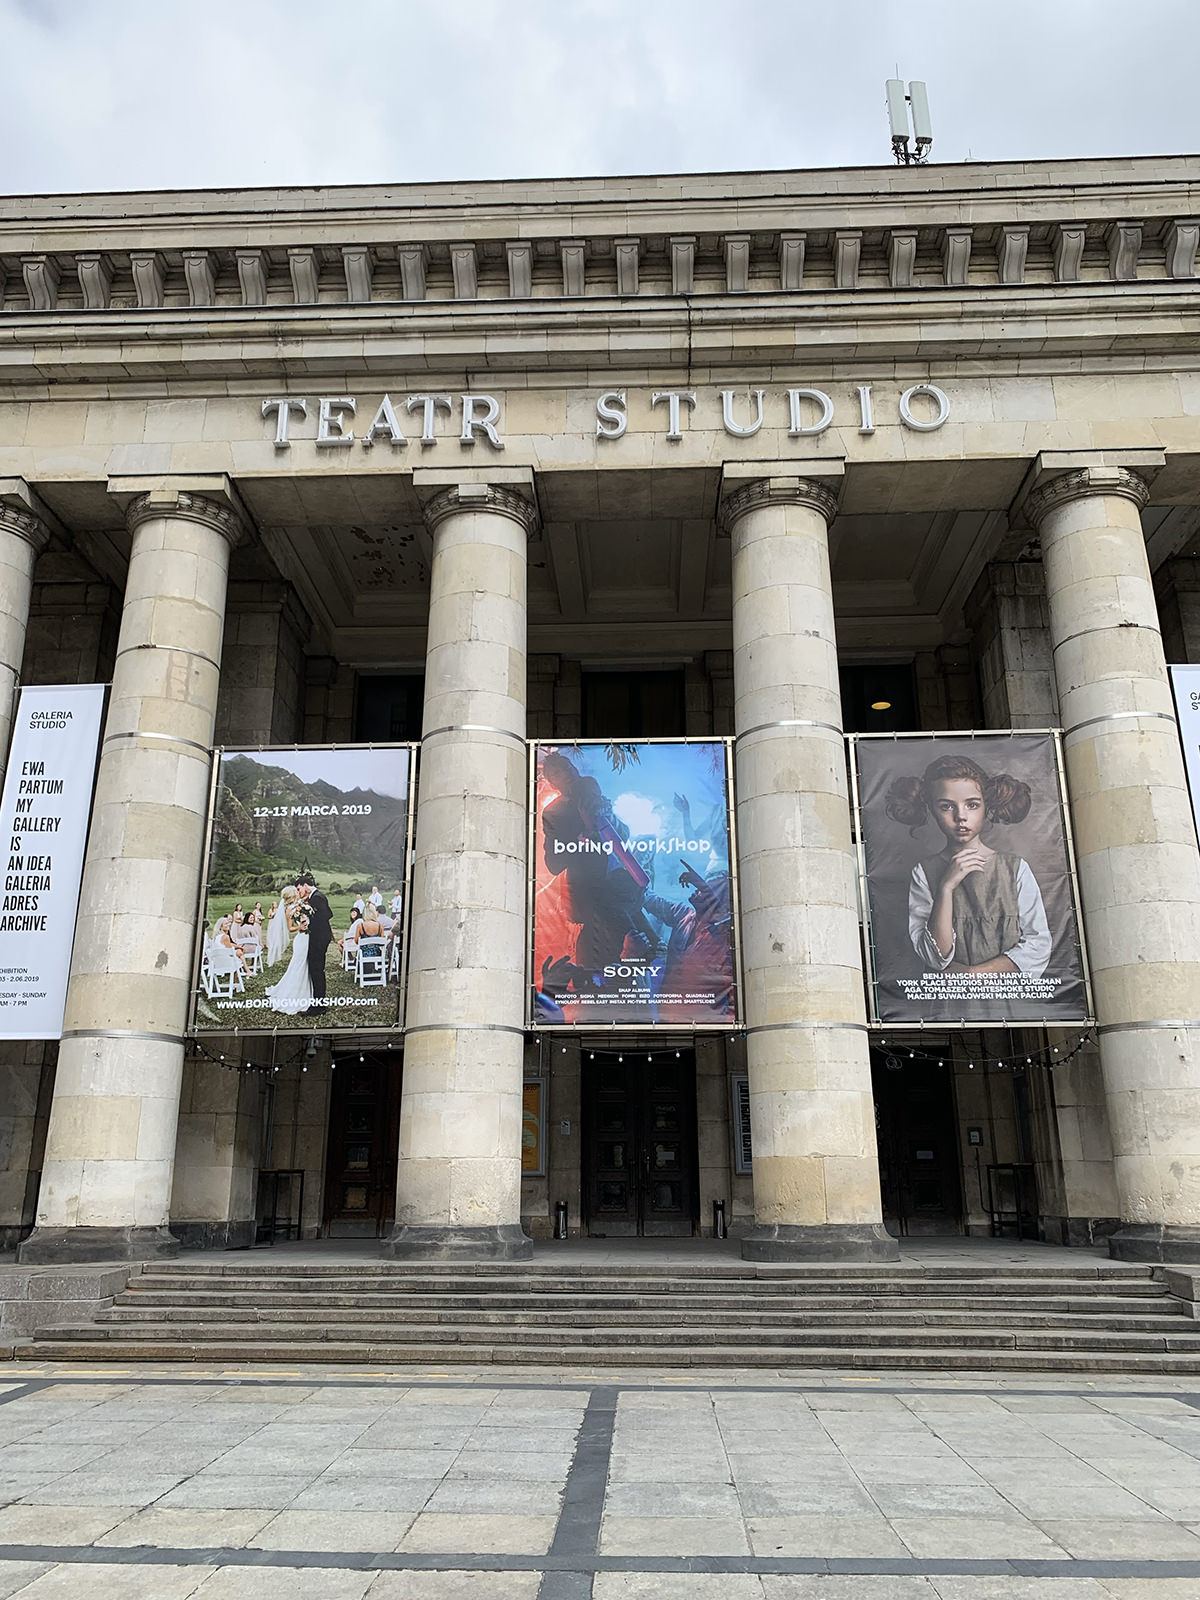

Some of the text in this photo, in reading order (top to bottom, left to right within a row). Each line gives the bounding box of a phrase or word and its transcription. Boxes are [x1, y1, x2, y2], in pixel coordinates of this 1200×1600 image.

[262, 384, 951, 449] TEATR STUDIO
[31, 711, 73, 720] GALERIA
[29, 720, 67, 729] STUDIO
[22, 761, 45, 775] EWA
[19, 780, 63, 794] PARTUM
[16, 798, 33, 812] MY
[253, 804, 372, 817] 12-13 MARCA 2019
[13, 817, 61, 832] GALLERY
[10, 836, 21, 851] IS
[7, 855, 52, 871] AN IDEA
[5, 875, 51, 891] GALERIA
[2, 895, 39, 911] ADRES
[0, 915, 47, 931] ARCHIVE
[603, 966, 662, 978] SONY
[217, 997, 378, 1009] www.BORINGWORKSHOP.com
